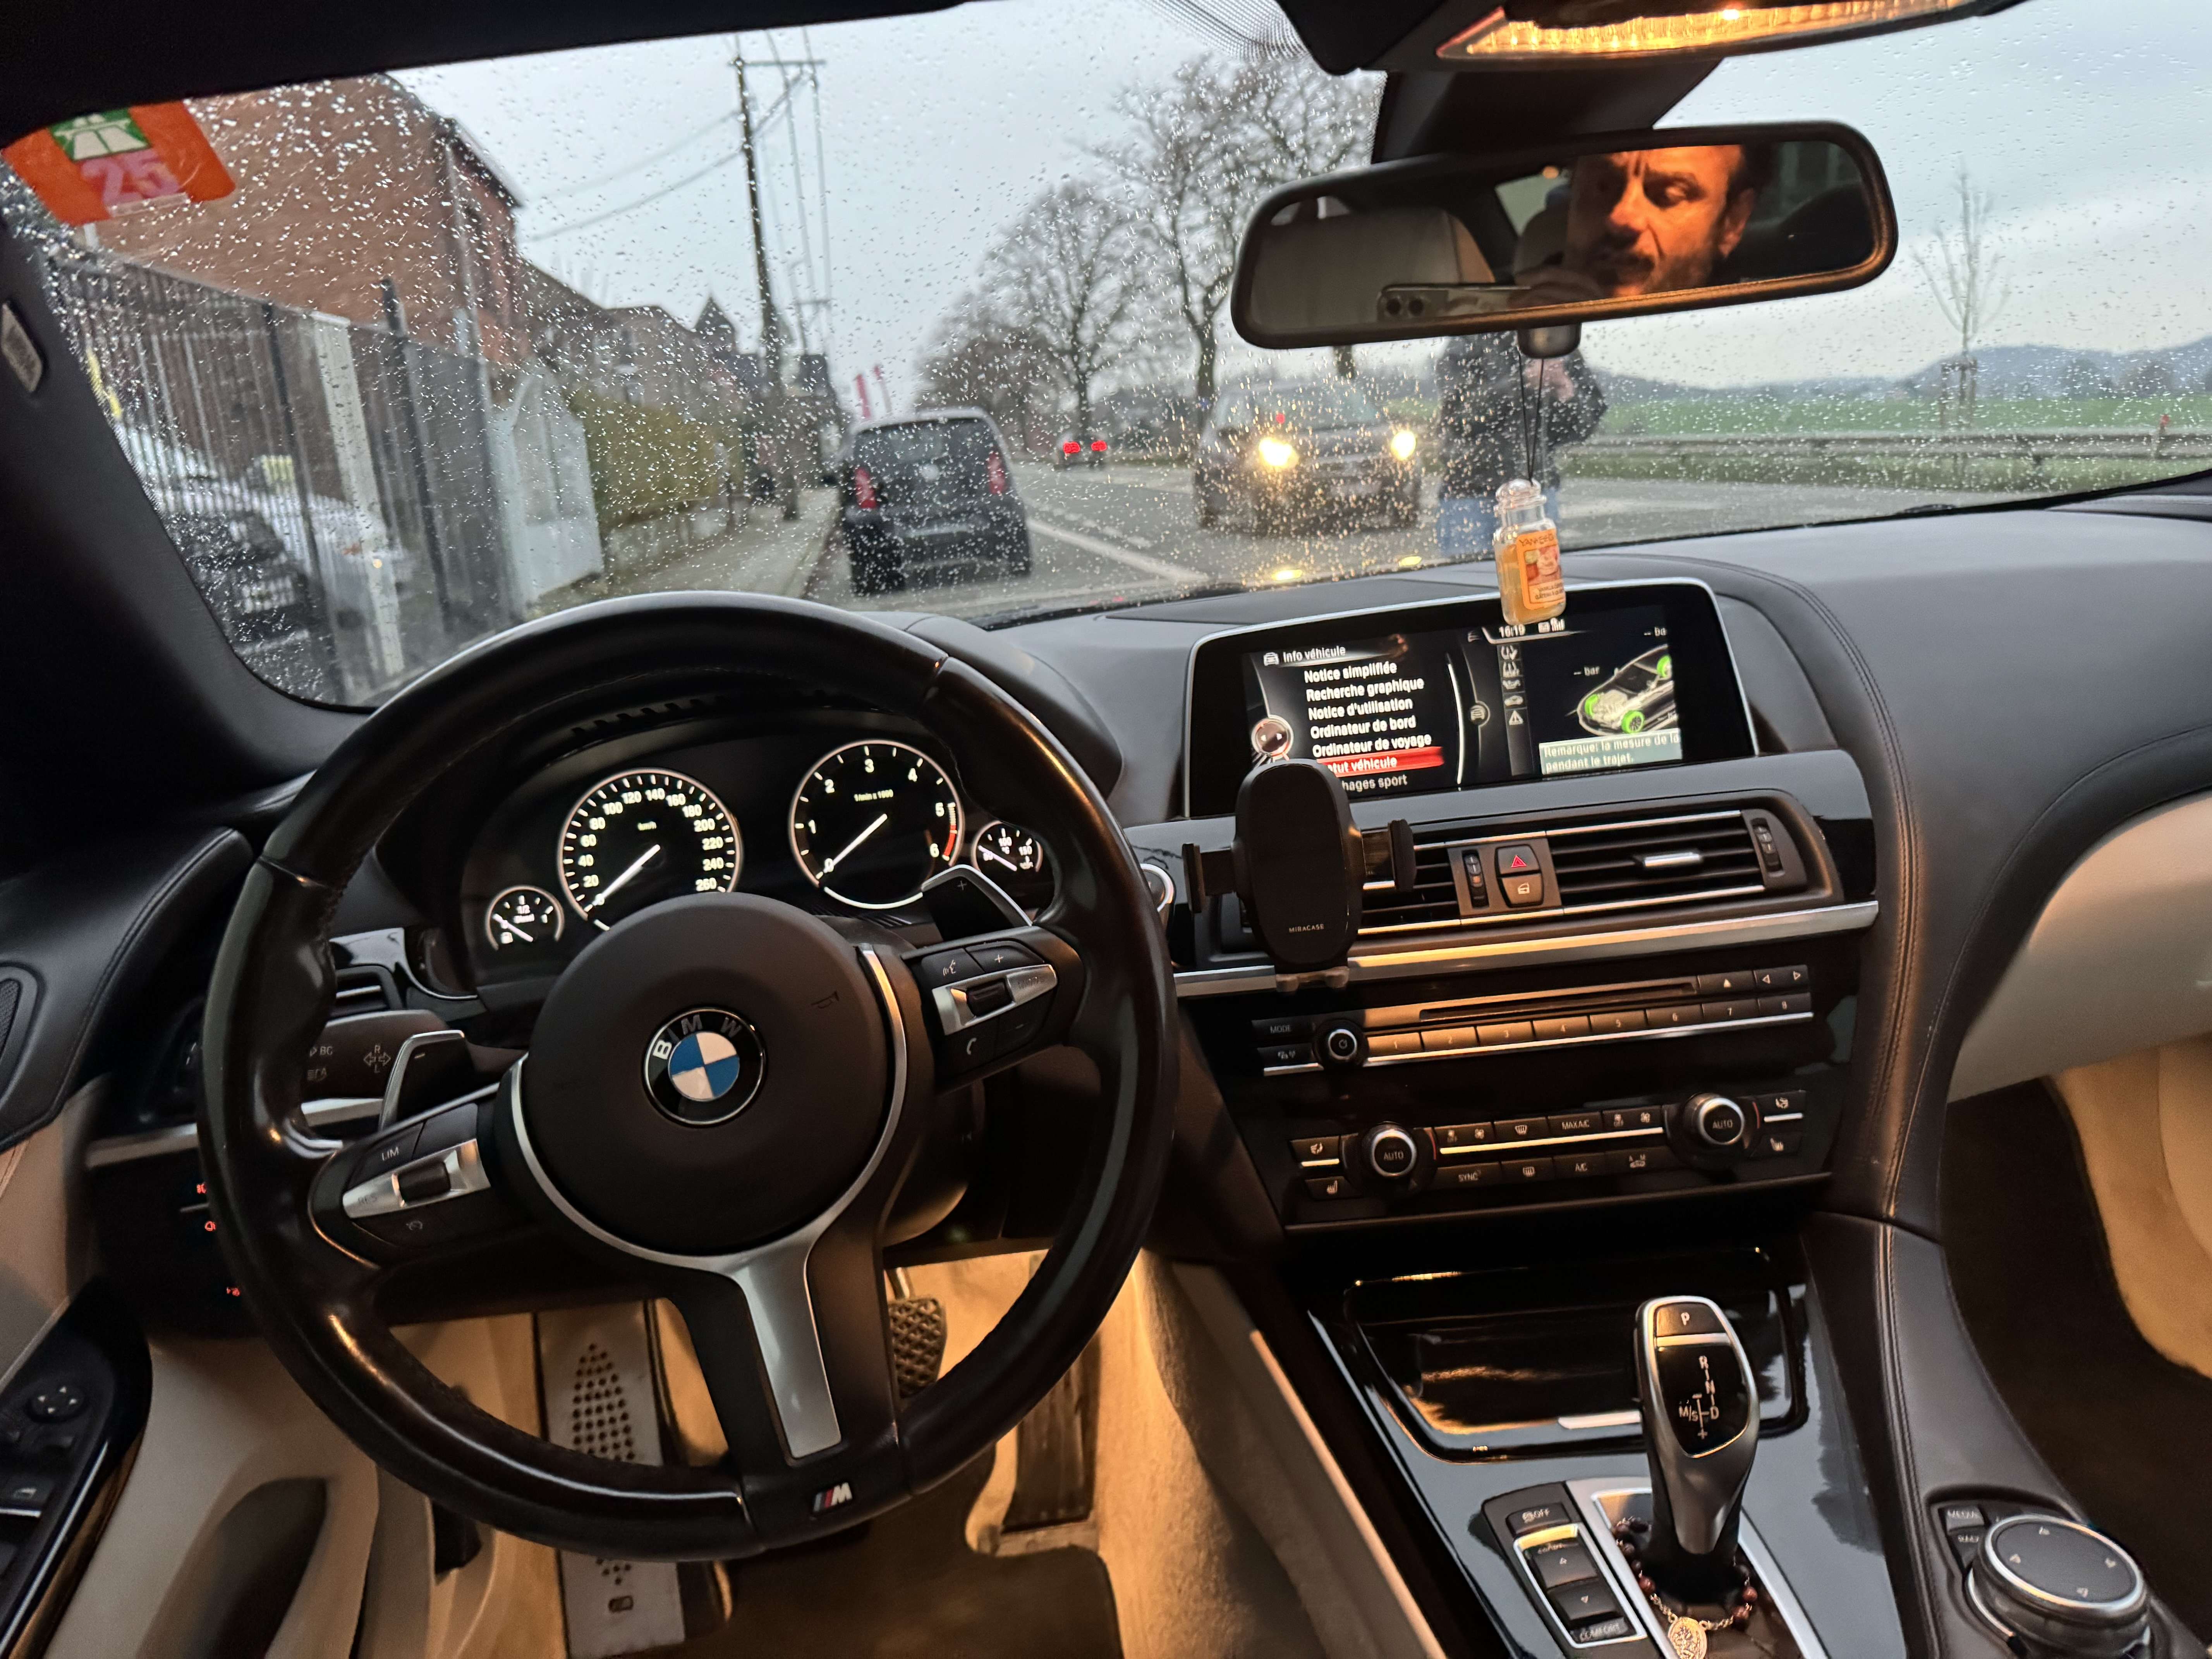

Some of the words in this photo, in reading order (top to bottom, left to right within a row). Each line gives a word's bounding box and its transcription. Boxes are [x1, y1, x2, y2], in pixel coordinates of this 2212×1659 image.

[1283, 651, 1303, 663] Info
[1304, 646, 1346, 660] véhicule
[1304, 668, 1341, 683] Notice
[1343, 661, 1397, 679] simplifiée
[1584, 666, 1600, 676] bar
[1306, 684, 1365, 702] Recherche
[1367, 678, 1425, 697] graphique
[1308, 706, 1345, 720] Notice
[1347, 698, 1413, 716] d'utilisation
[1310, 721, 1370, 739] Ordinateur
[1372, 719, 1387, 732] de
[1389, 715, 1416, 730] bord
[1312, 740, 1372, 757] Ordinateur
[1375, 737, 1389, 751] de
[1392, 734, 1432, 750] voyage
[1614, 738, 1651, 750] mesure
[865, 759, 874, 773] 3
[1352, 756, 1397, 773] véhicule
[1546, 758, 1588, 775] pendant
[908, 768, 918, 782] 4
[824, 779, 835, 794] 2
[1378, 775, 1408, 790] sport
[621, 790, 642, 804] 120
[645, 788, 665, 801] 140
[666, 793, 686, 807] 160
[603, 801, 623, 815] 100
[682, 804, 702, 818] 180
[935, 802, 945, 817] 5
[589, 817, 606, 830] 80
[694, 818, 715, 832] 200
[808, 819, 816, 834] 1
[580, 834, 597, 848] 60
[702, 836, 723, 850] 220
[998, 836, 1012, 847] 100
[929, 843, 940, 858] 6
[578, 854, 594, 867] 40
[703, 857, 724, 872] 240
[582, 875, 599, 888] 20
[695, 878, 717, 892] 260
[1289, 924, 1324, 933] MIRACASE
[1727, 1007, 1732, 1016] 7
[1782, 1001, 1787, 1010] 8
[1672, 1012, 1678, 1021] 6
[653, 1014, 742, 1060] BMW
[319, 1046, 333, 1056] BC
[1712, 1120, 1733, 1129] AUTO
[382, 1147, 399, 1161] LIM
[1383, 1151, 1404, 1161] AUTO
[1680, 1312, 1690, 1326] P
[1698, 1355, 1709, 1370] R
[1705, 1379, 1715, 1394] N
[1679, 1404, 1698, 1422] M/S
[1710, 1406, 1719, 1420] D
